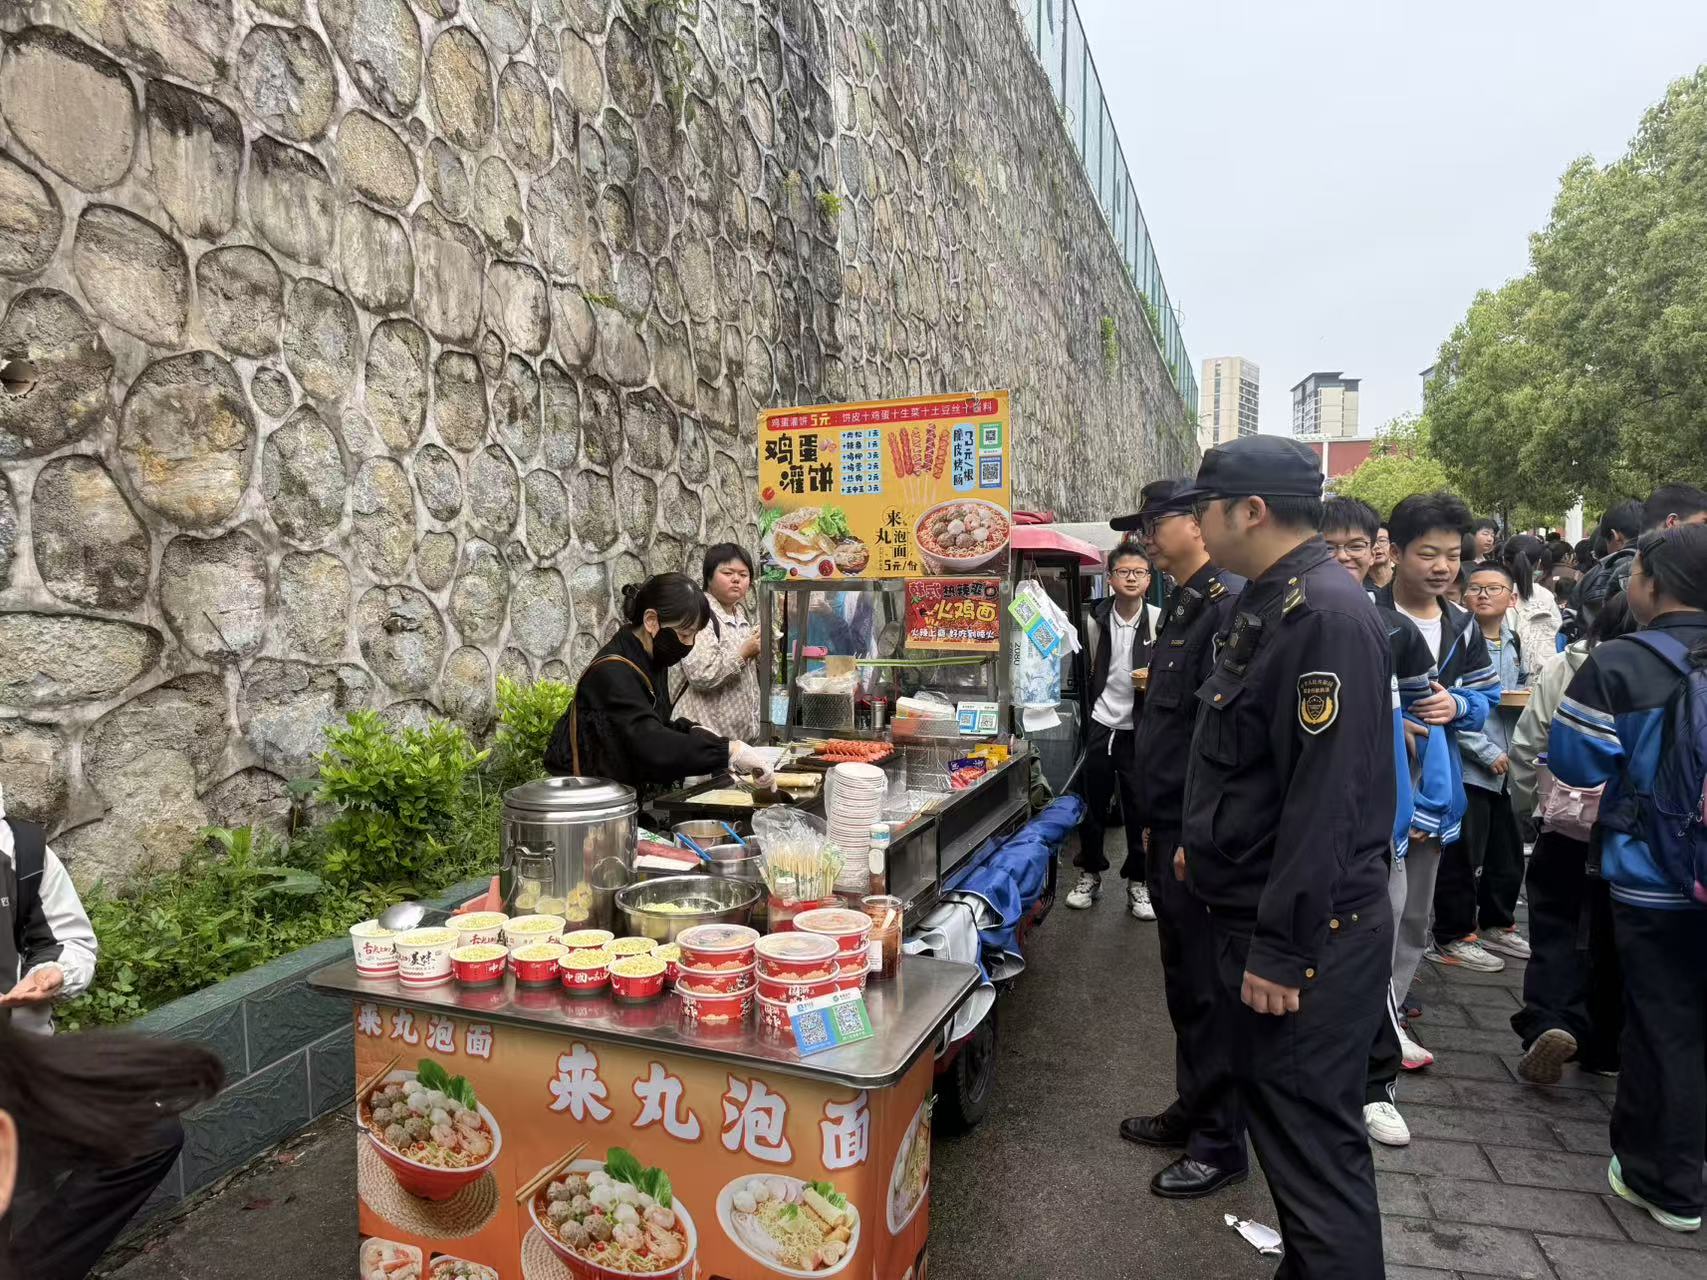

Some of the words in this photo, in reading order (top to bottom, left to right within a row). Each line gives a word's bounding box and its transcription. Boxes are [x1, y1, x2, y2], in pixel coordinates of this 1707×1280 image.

[765, 433, 819, 465] 鸡蛋
[867, 451, 879, 459] 3元
[779, 462, 834, 494] 灌饼
[867, 484, 879, 492] 3元
[884, 560, 918, 571] 5元/份
[934, 599, 997, 622] 火鸡面
[357, 1003, 494, 1060] 来丸泡面
[548, 1041, 872, 1171] 来丸泡面
